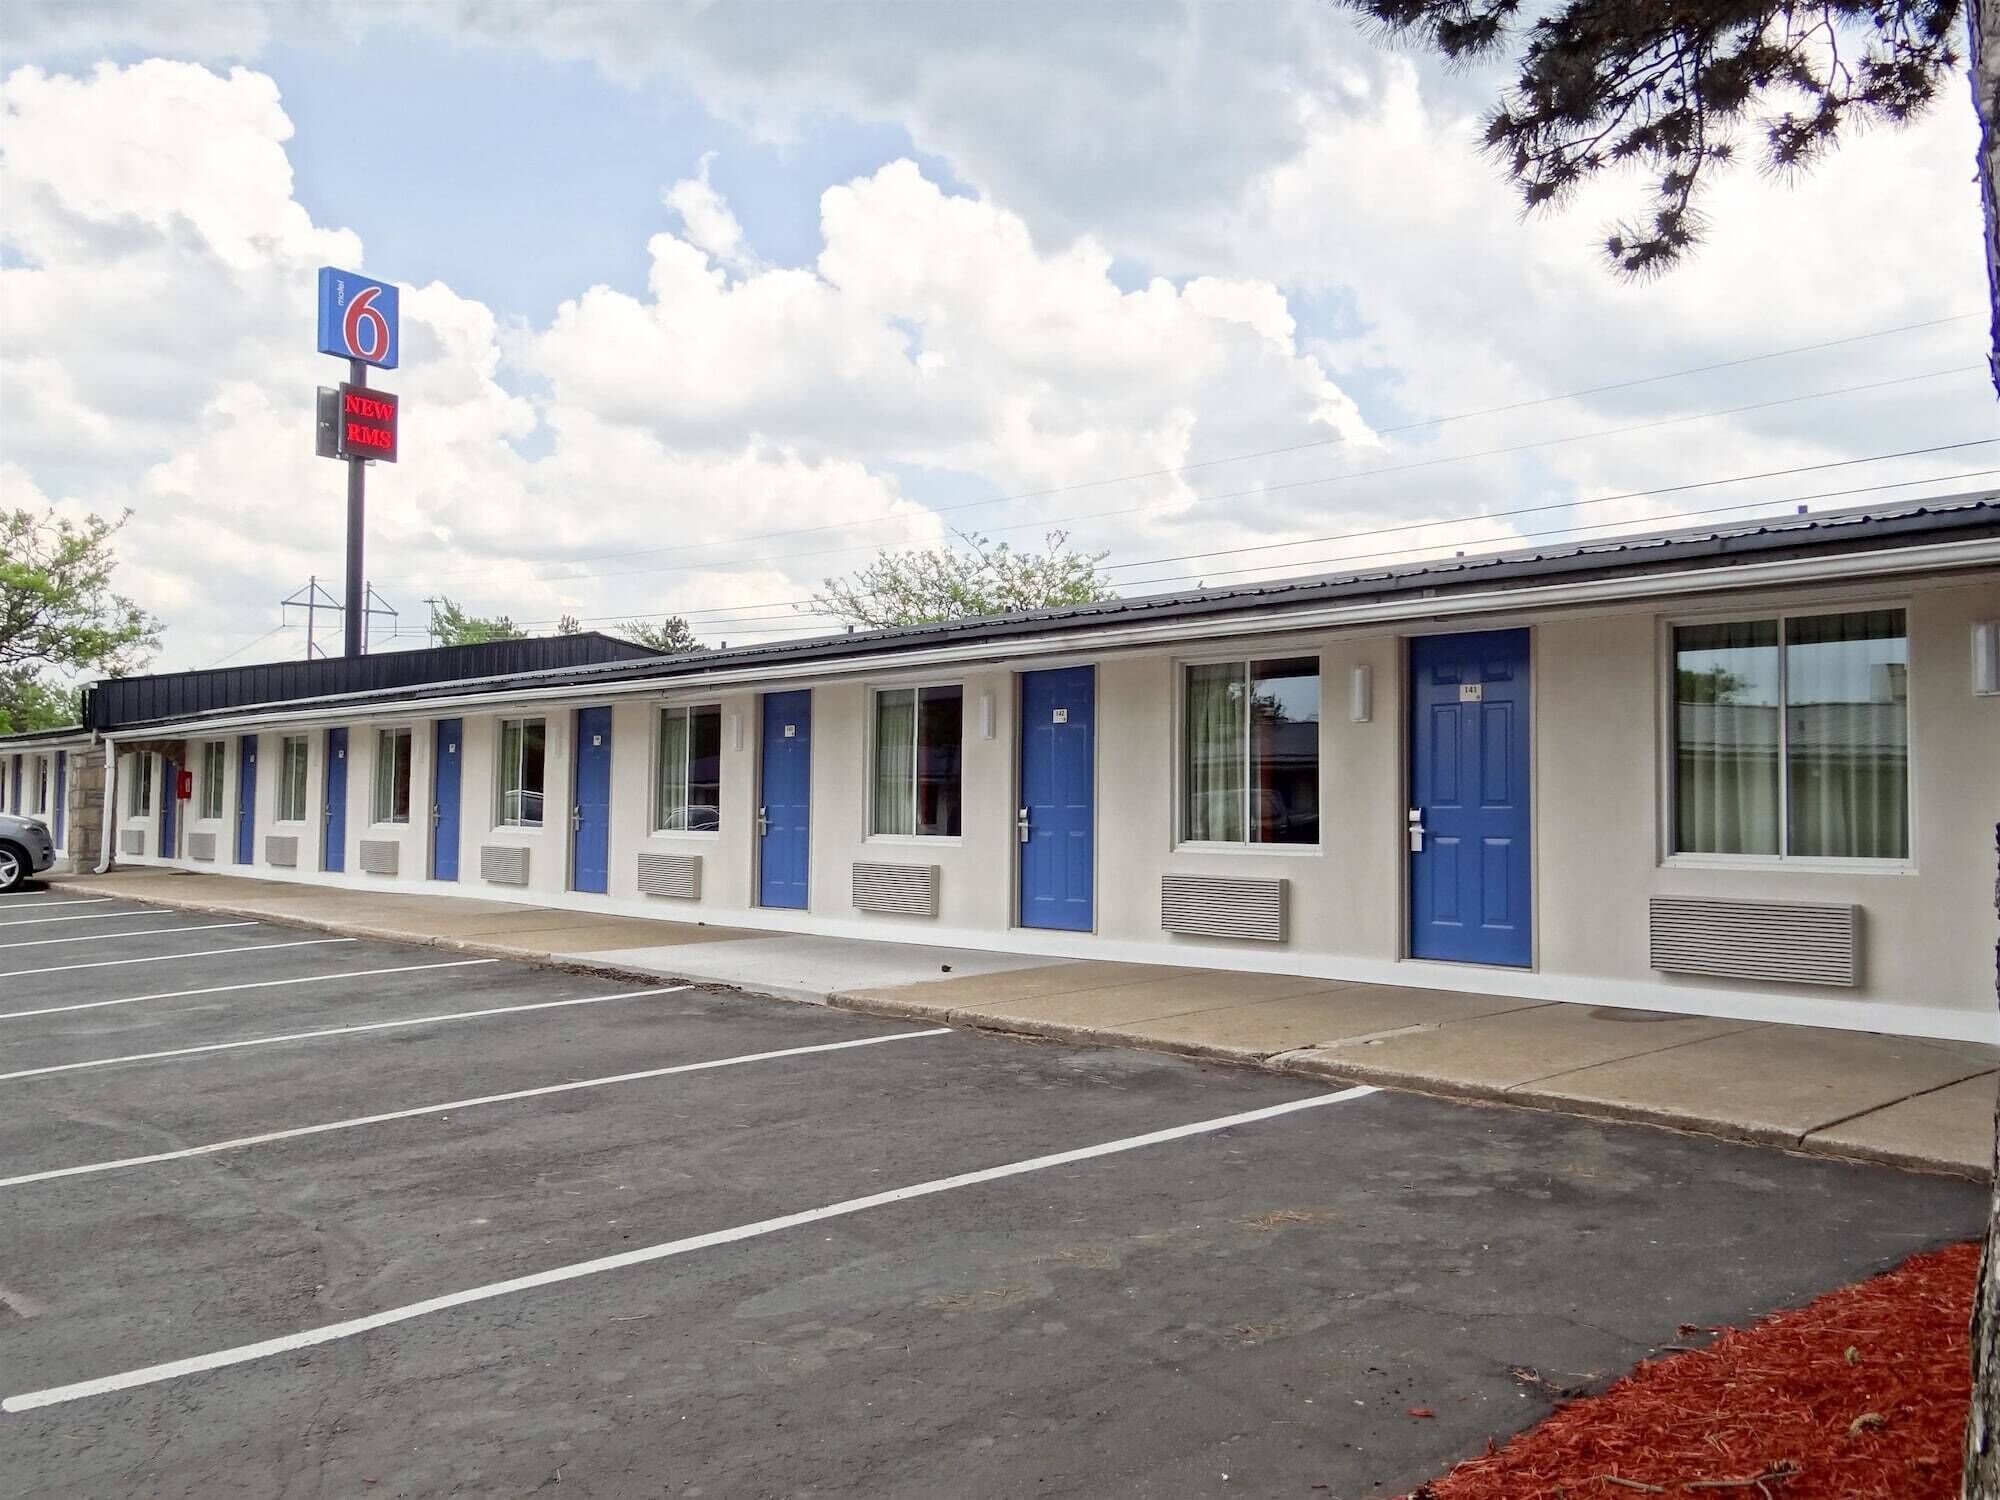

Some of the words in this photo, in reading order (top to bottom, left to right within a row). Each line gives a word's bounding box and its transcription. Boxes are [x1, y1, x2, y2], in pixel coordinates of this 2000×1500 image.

[337, 280, 345, 306] motel
[342, 286, 390, 362] 6
[345, 395, 393, 421] NEW
[347, 423, 392, 449] RMS
[1465, 686, 1477, 694] 141
